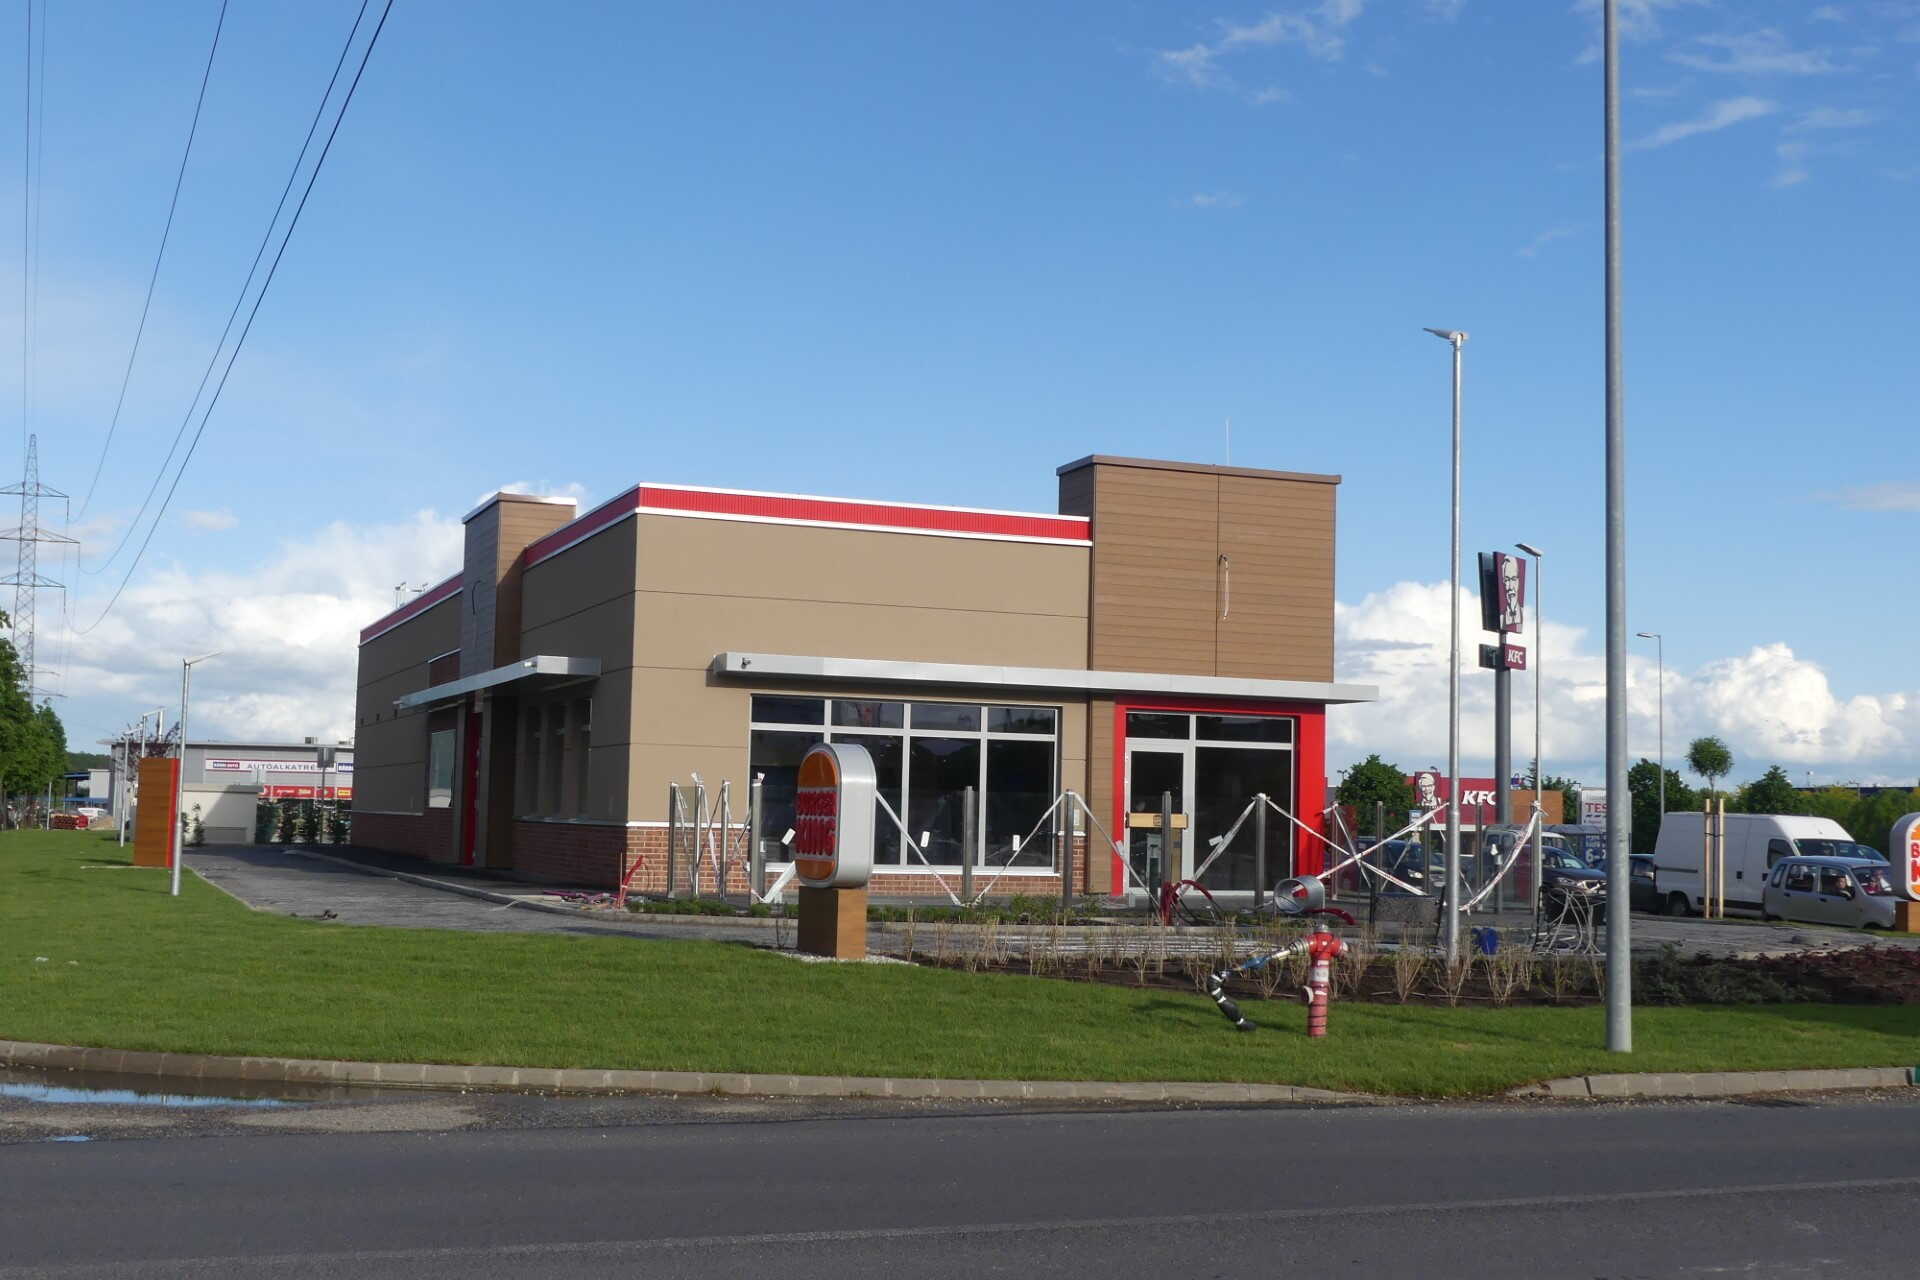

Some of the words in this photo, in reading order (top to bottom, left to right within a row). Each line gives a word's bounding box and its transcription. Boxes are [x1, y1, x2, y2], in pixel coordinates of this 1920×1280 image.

[1508, 649, 1523, 664] KFC
[1462, 790, 1496, 806] KFC
[1585, 802, 1608, 814] TES
